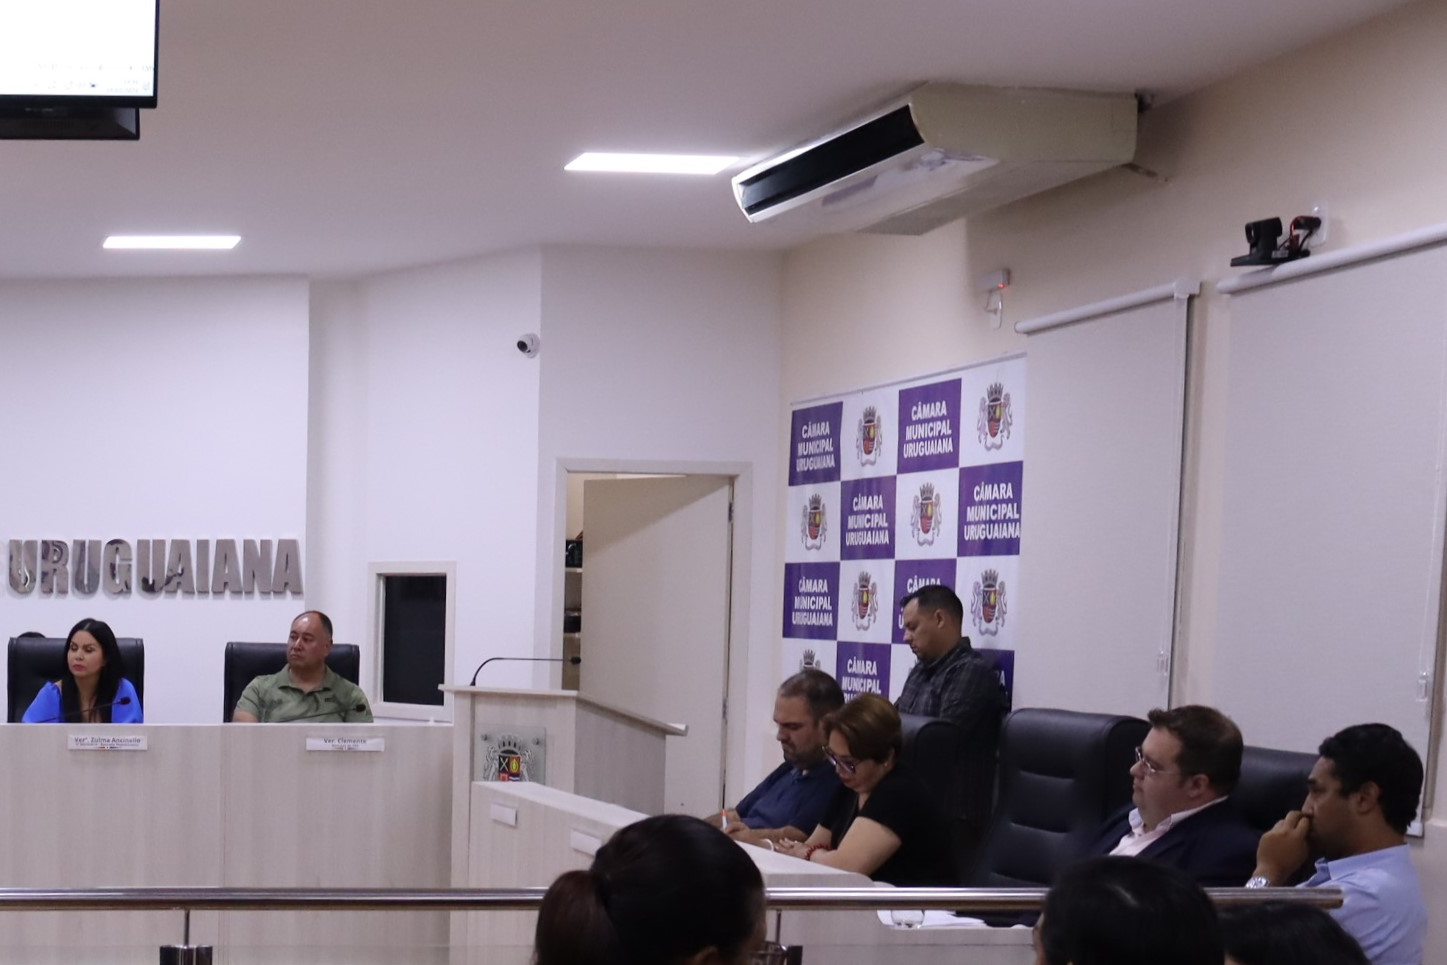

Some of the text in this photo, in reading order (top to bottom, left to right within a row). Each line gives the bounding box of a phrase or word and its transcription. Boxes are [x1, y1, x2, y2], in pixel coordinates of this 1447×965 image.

[911, 400, 947, 420] CÂMARA
[802, 420, 830, 438] CÂMARA
[905, 419, 952, 440] MUNICIPAL
[797, 438, 834, 455] MUNICIPAL
[903, 438, 953, 458] URUGUAIANA
[796, 455, 835, 472] URUGUAIANA
[974, 481, 1013, 501] CÂMARA
[853, 493, 883, 511] CÂMARA
[966, 501, 1019, 521] MUNICIPAL
[848, 511, 888, 529] MUNICIPAL
[845, 529, 889, 546] URUGUAIANA
[964, 521, 1020, 541] URUGUAIANA
[8, 538, 302, 594] URUGUAIANA
[798, 575, 828, 593] CÂMARA
[794, 595, 832, 610] MUNICIPAL
[792, 611, 833, 626] URUGUAIANA
[847, 657, 877, 675] CÂMARA
[842, 676, 881, 693] MUNICIPAL
